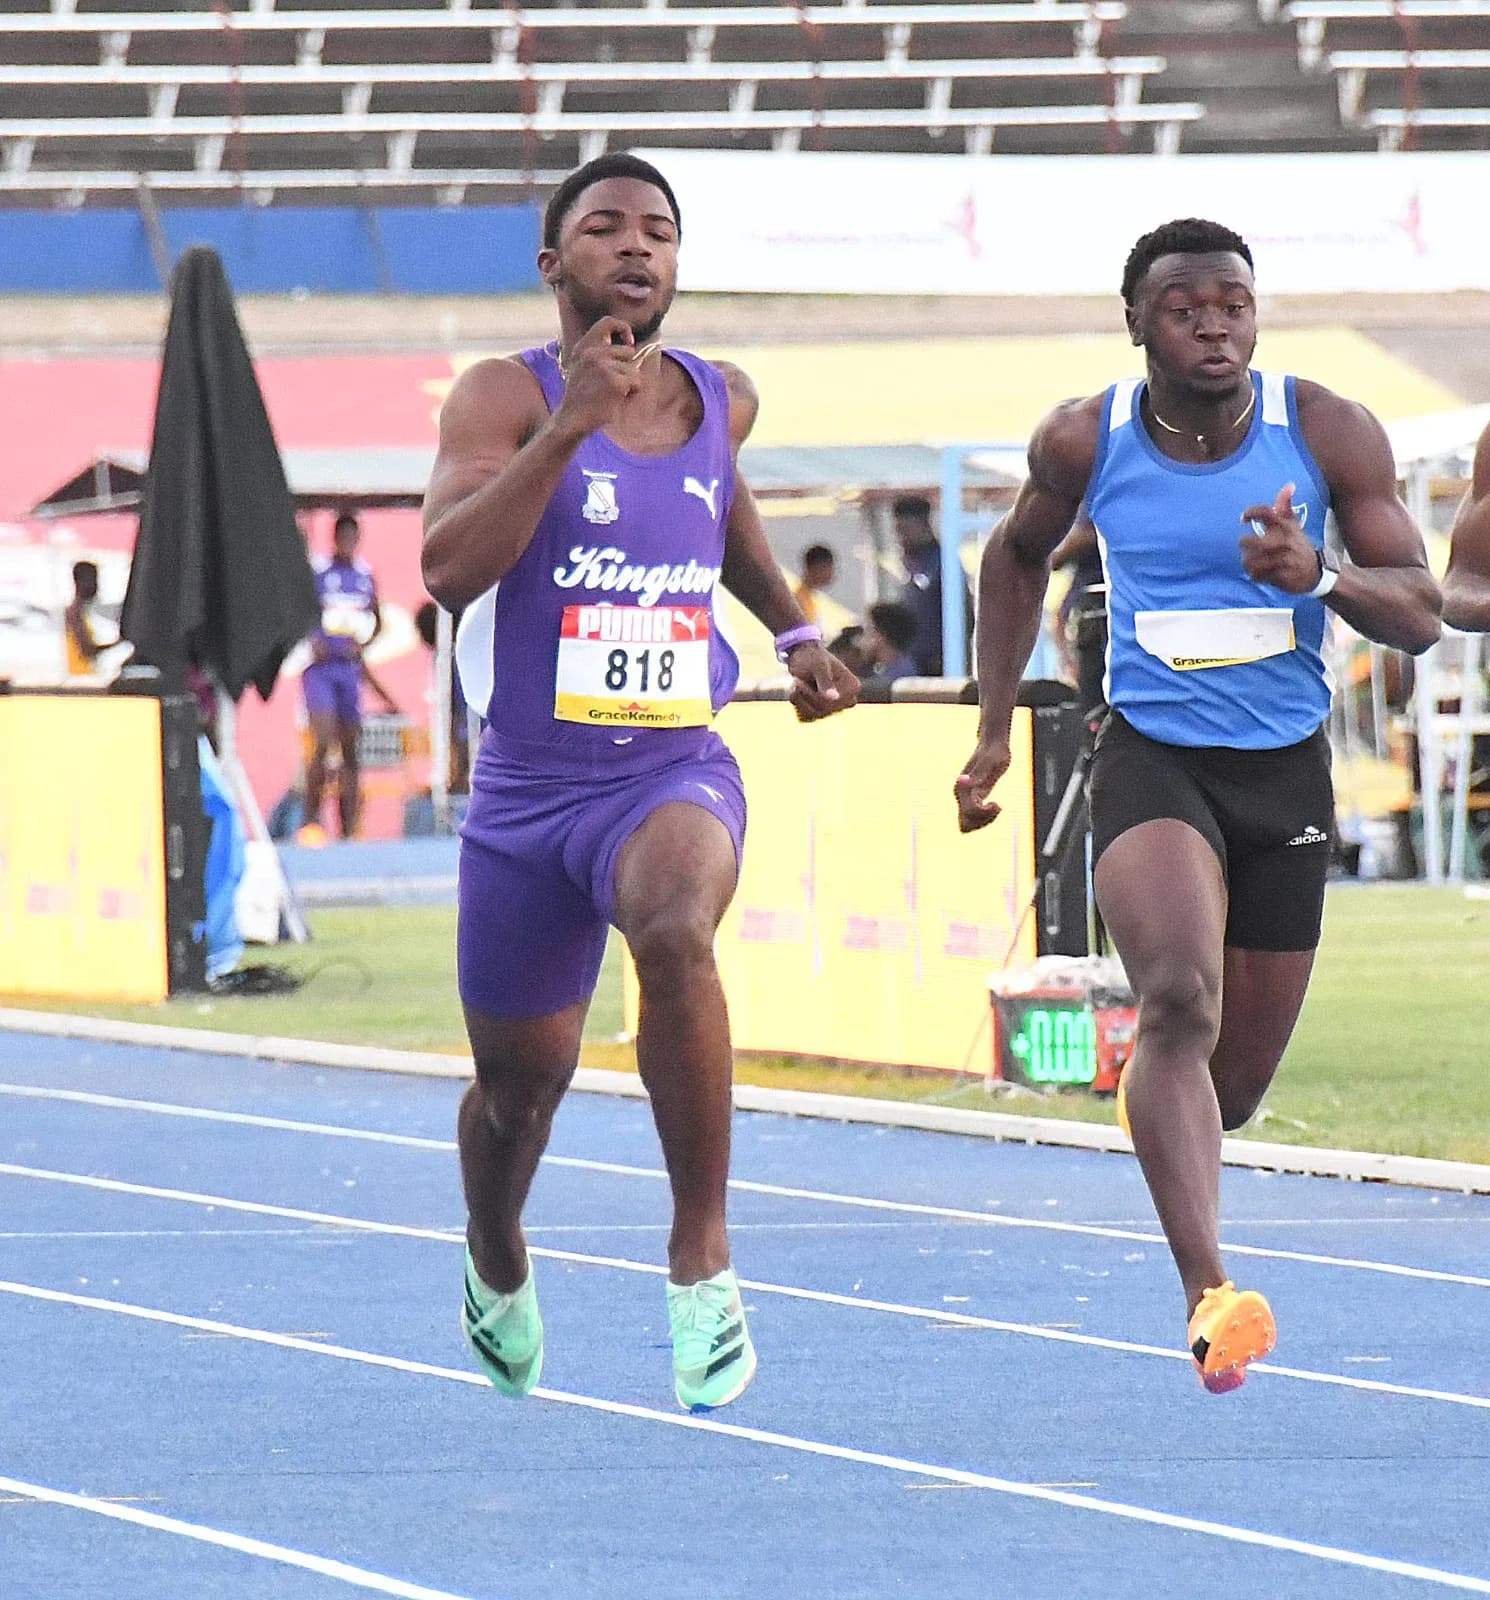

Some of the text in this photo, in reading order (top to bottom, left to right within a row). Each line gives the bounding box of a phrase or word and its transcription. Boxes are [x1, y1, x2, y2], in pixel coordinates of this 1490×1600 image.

[577, 608, 673, 642] PUMA
[604, 648, 676, 692] 818
[588, 709, 681, 723] GraceKennedy
